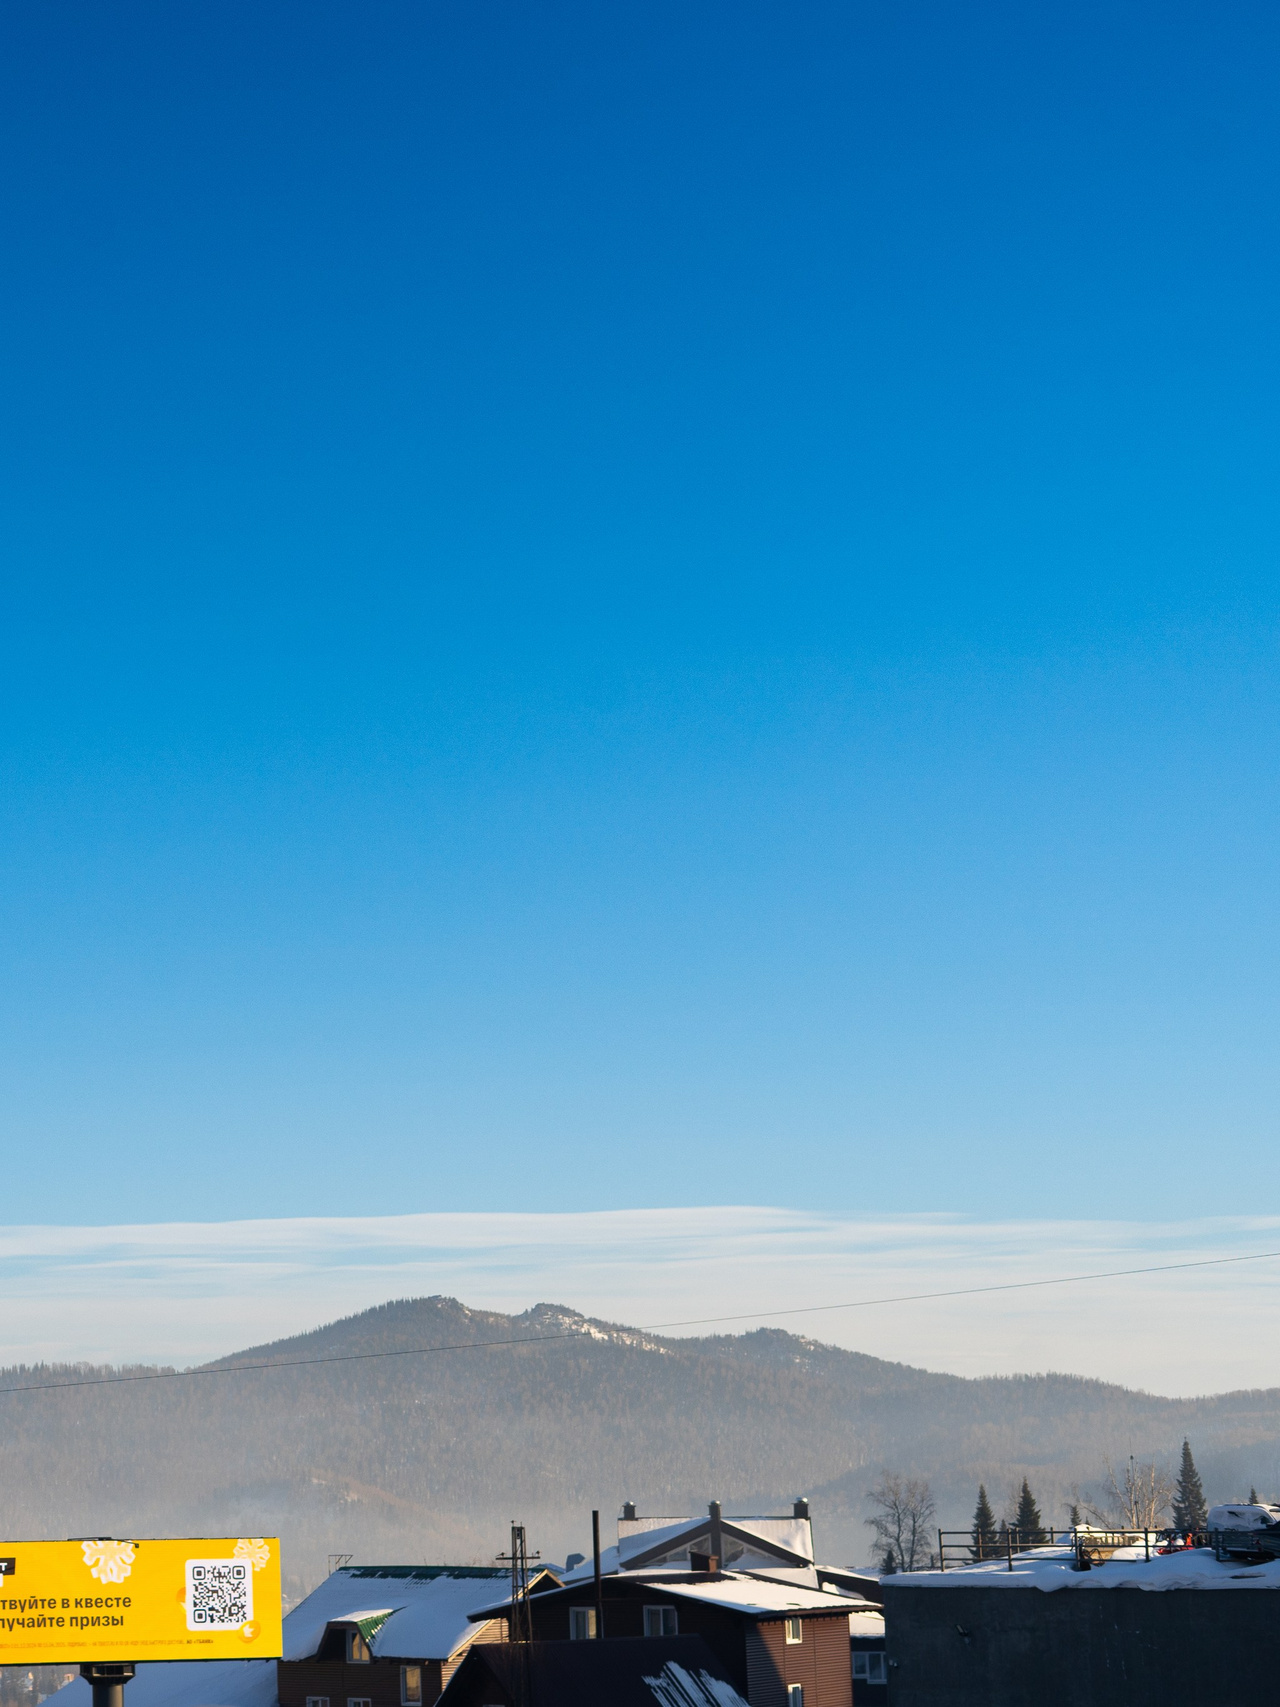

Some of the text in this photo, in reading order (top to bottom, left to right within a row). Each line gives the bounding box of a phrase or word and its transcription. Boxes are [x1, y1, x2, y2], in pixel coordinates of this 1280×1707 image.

[61, 1599, 70, 1609] в
[74, 1597, 132, 1609] квесте
[69, 1614, 124, 1630] призы
